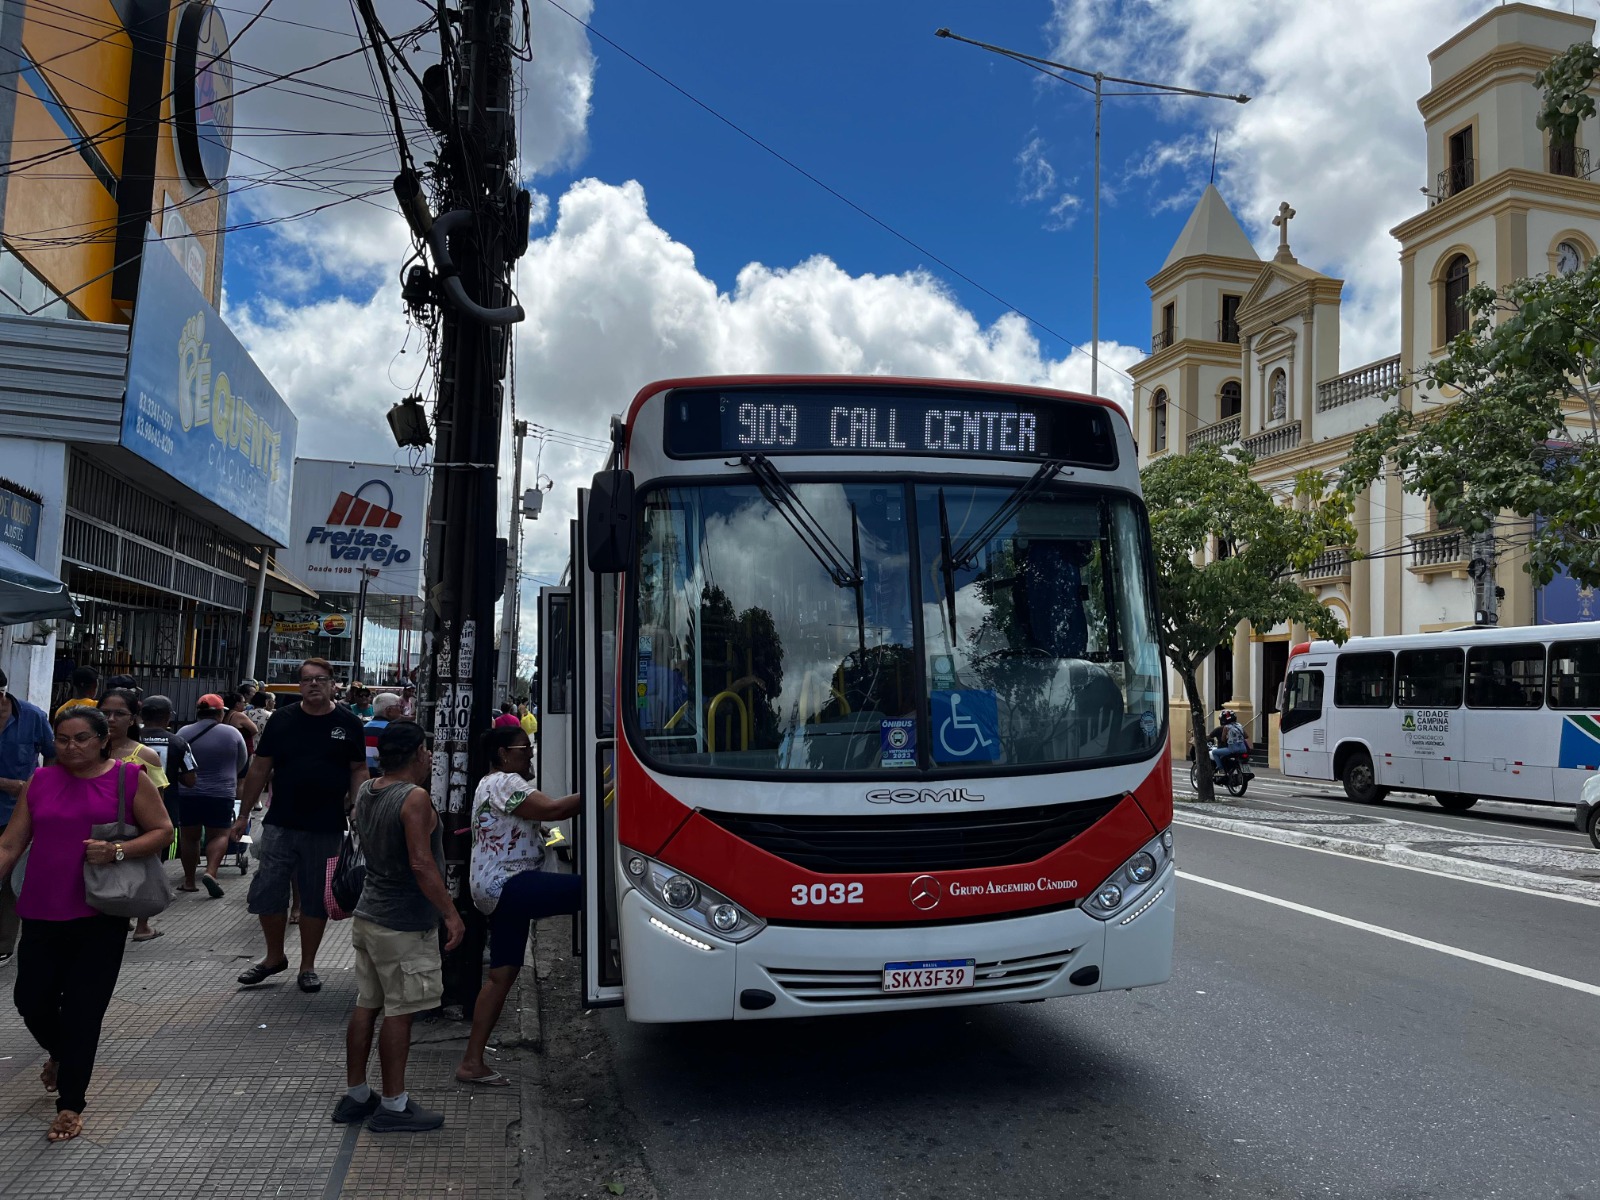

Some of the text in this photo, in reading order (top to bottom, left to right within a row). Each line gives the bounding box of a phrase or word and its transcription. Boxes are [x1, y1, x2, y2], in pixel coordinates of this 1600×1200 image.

[212, 371, 281, 484] QUENTE
[738, 403, 1036, 451] 909 CALL CENTER
[306, 526, 393, 547] Freitas
[330, 544, 411, 567] varejo
[308, 565, 332, 573] Desde
[882, 720, 912, 728] ÔNIBUS
[866, 788, 985, 804] COMIL
[791, 882, 864, 905] 3032
[891, 968, 965, 989] SKX3F39
